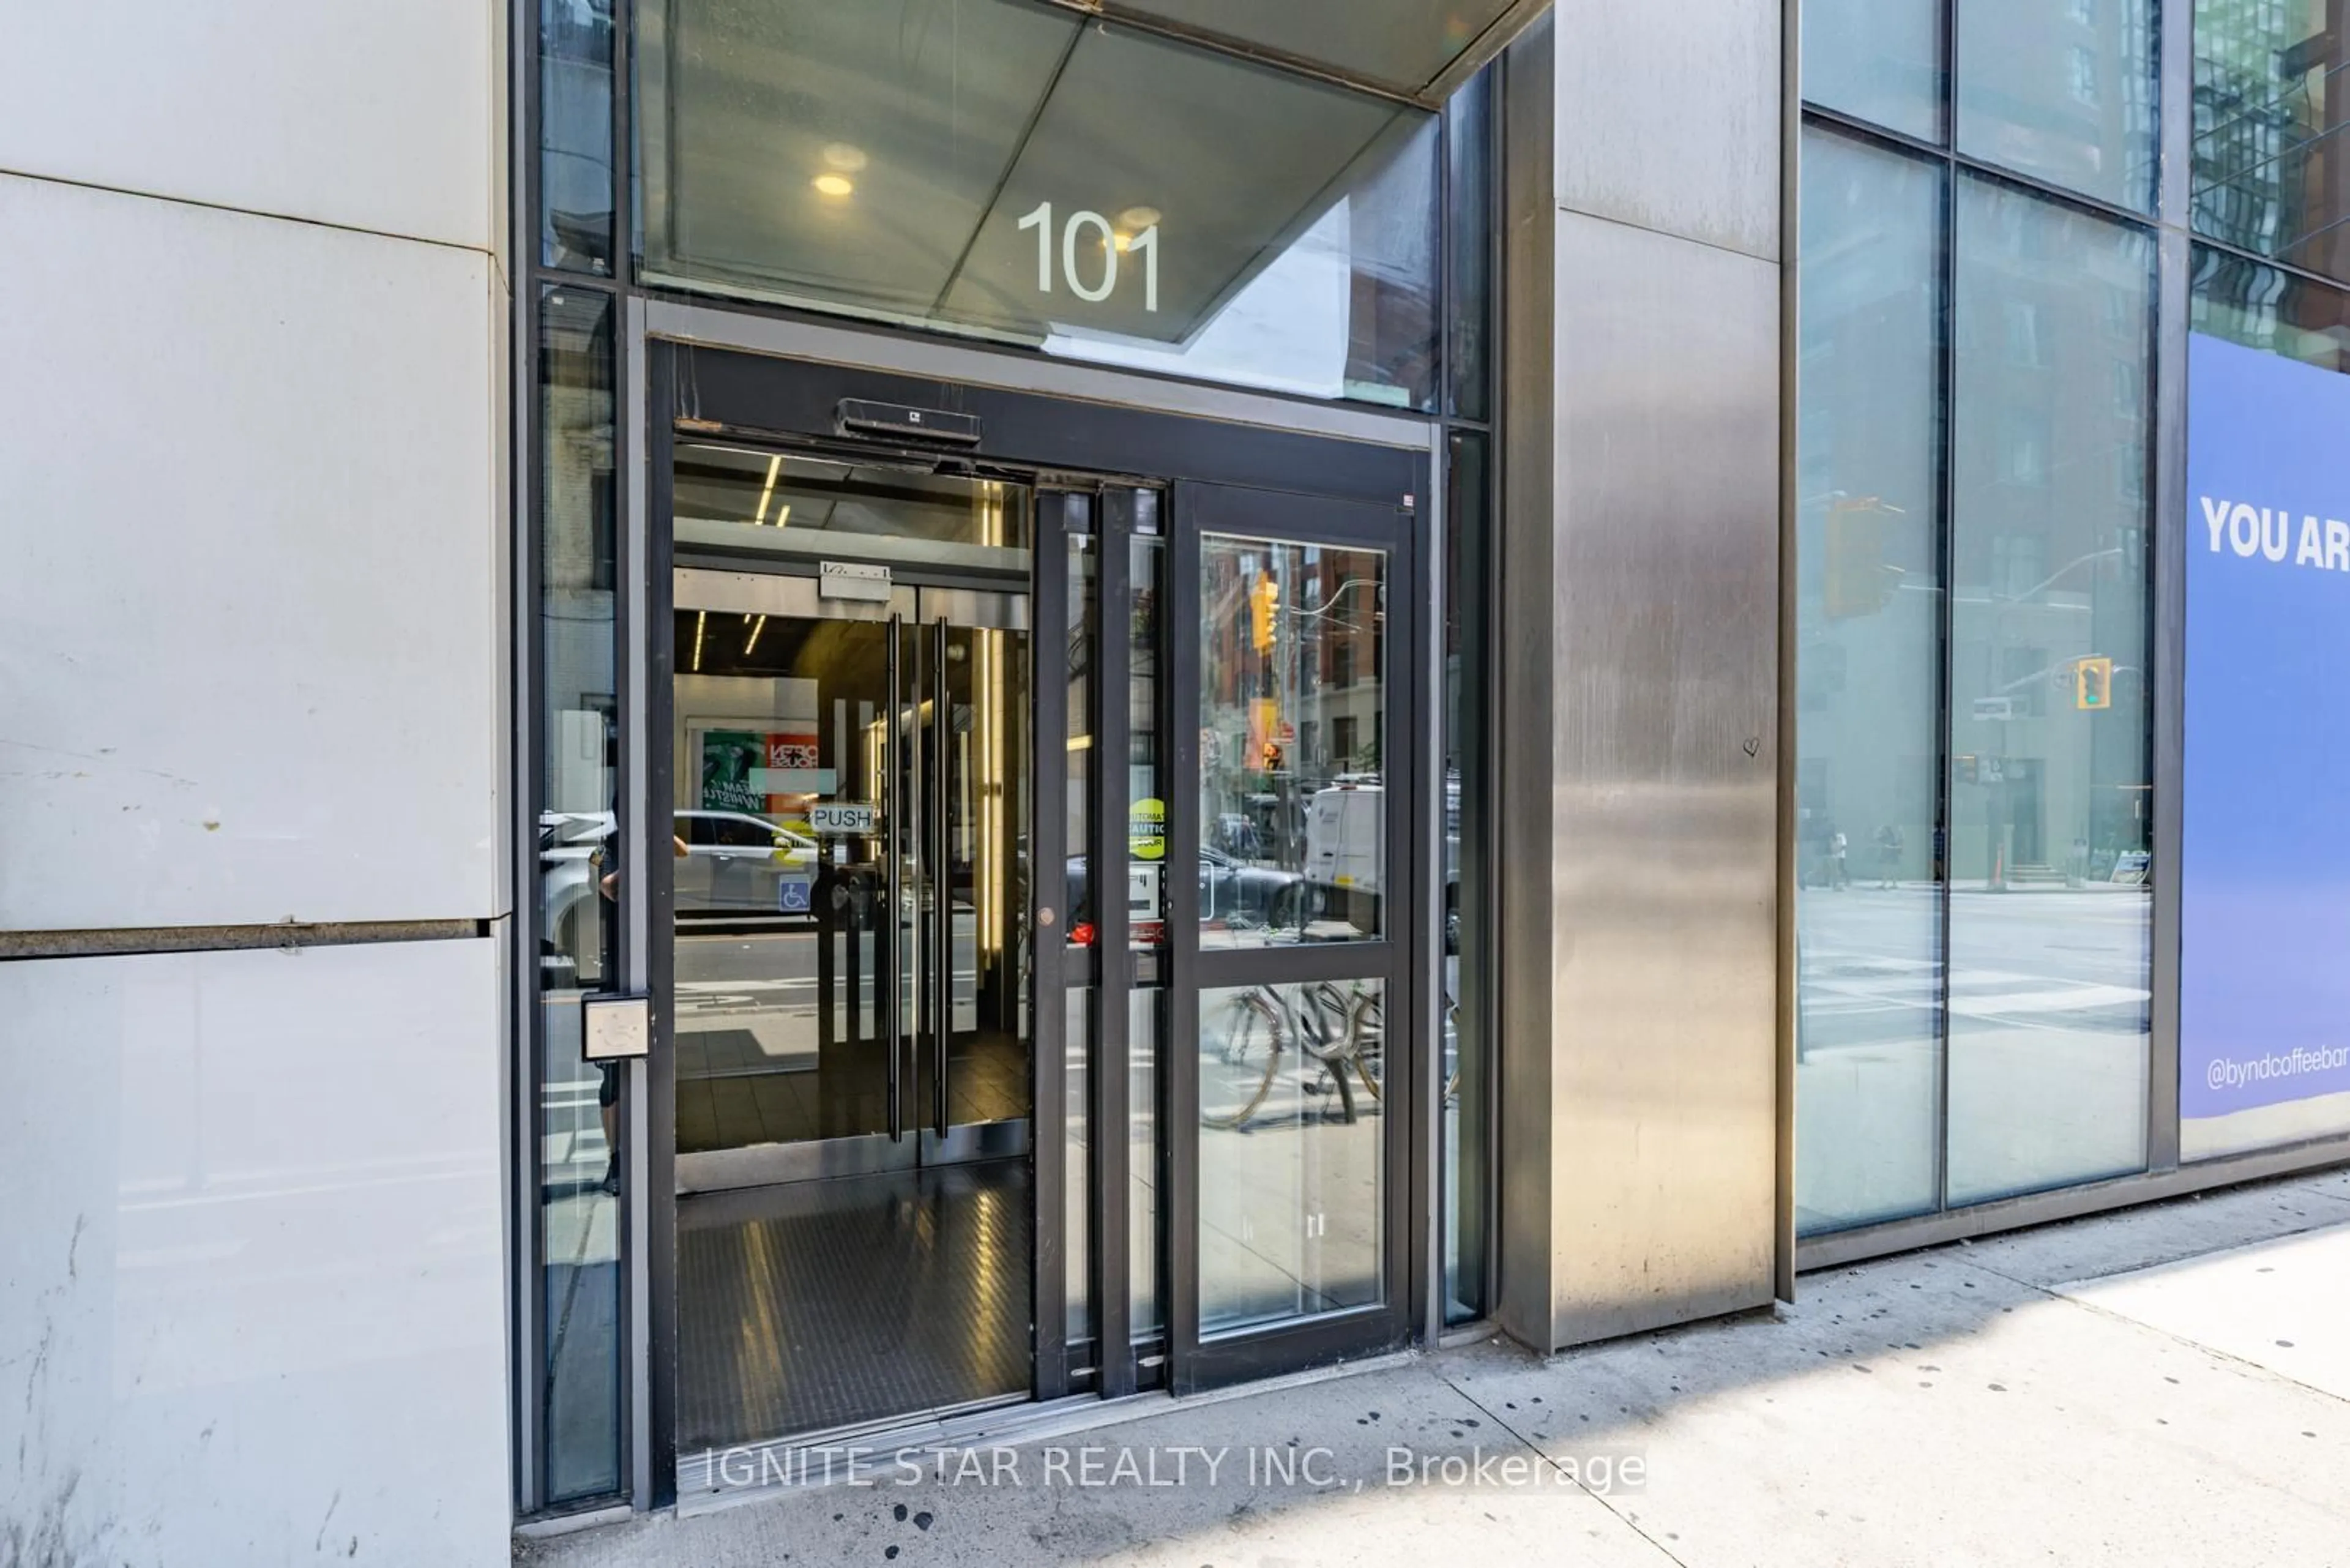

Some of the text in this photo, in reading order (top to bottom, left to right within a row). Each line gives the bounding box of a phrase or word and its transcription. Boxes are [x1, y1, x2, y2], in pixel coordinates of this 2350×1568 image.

[1018, 201, 1158, 312] 101
[2200, 496, 2350, 572] YOU AR
[814, 810, 870, 827] PUSH
[2207, 1045, 2350, 1089] @byndcoffeebar
